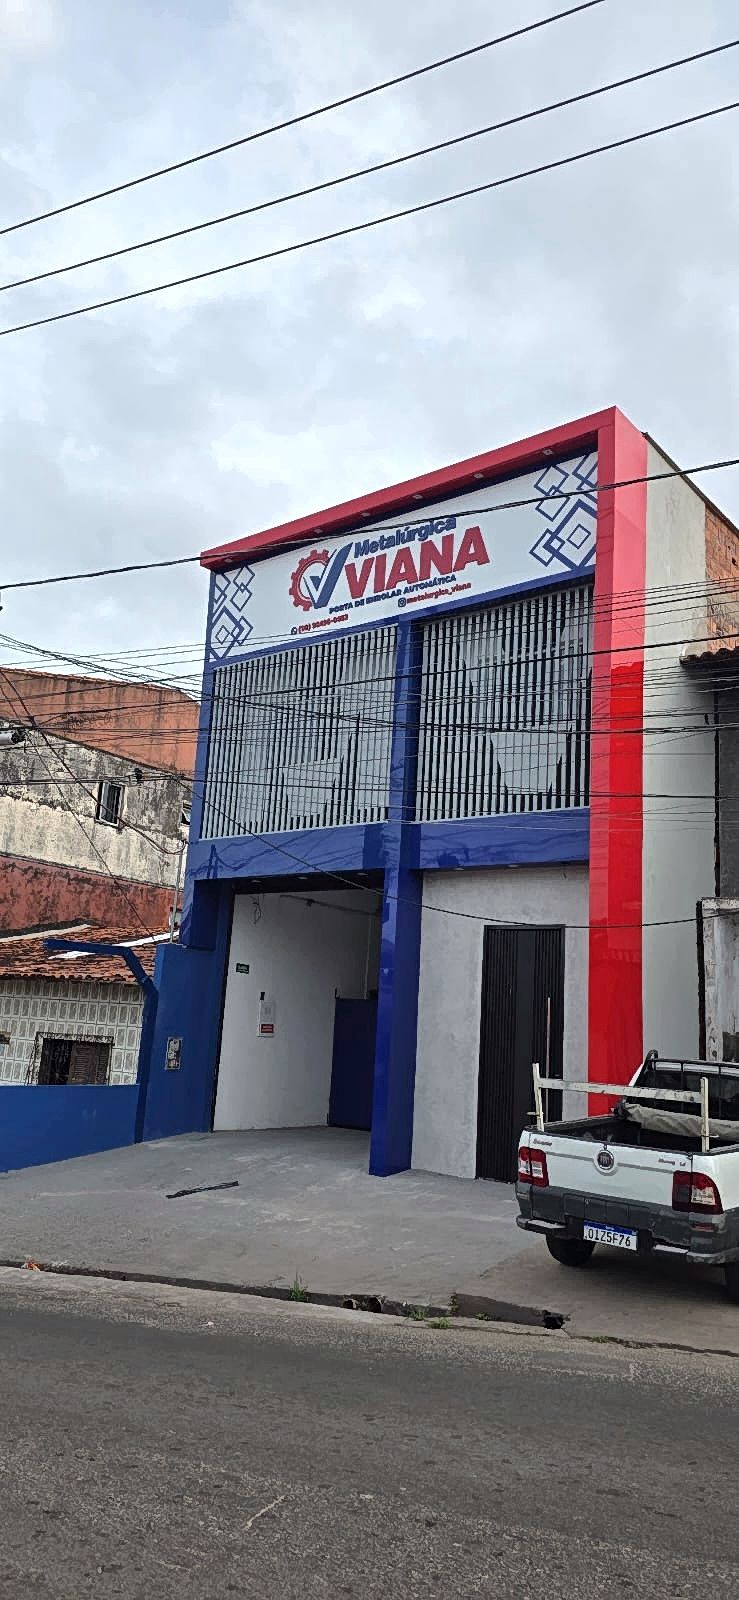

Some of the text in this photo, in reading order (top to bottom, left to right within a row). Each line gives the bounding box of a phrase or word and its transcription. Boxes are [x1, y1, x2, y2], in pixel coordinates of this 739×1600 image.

[354, 517, 456, 558] Metalúrgica
[344, 526, 490, 599] VIANA
[329, 603, 353, 614] PORTA
[354, 599, 365, 608] DE
[403, 574, 457, 594] AUTOMÁTICA
